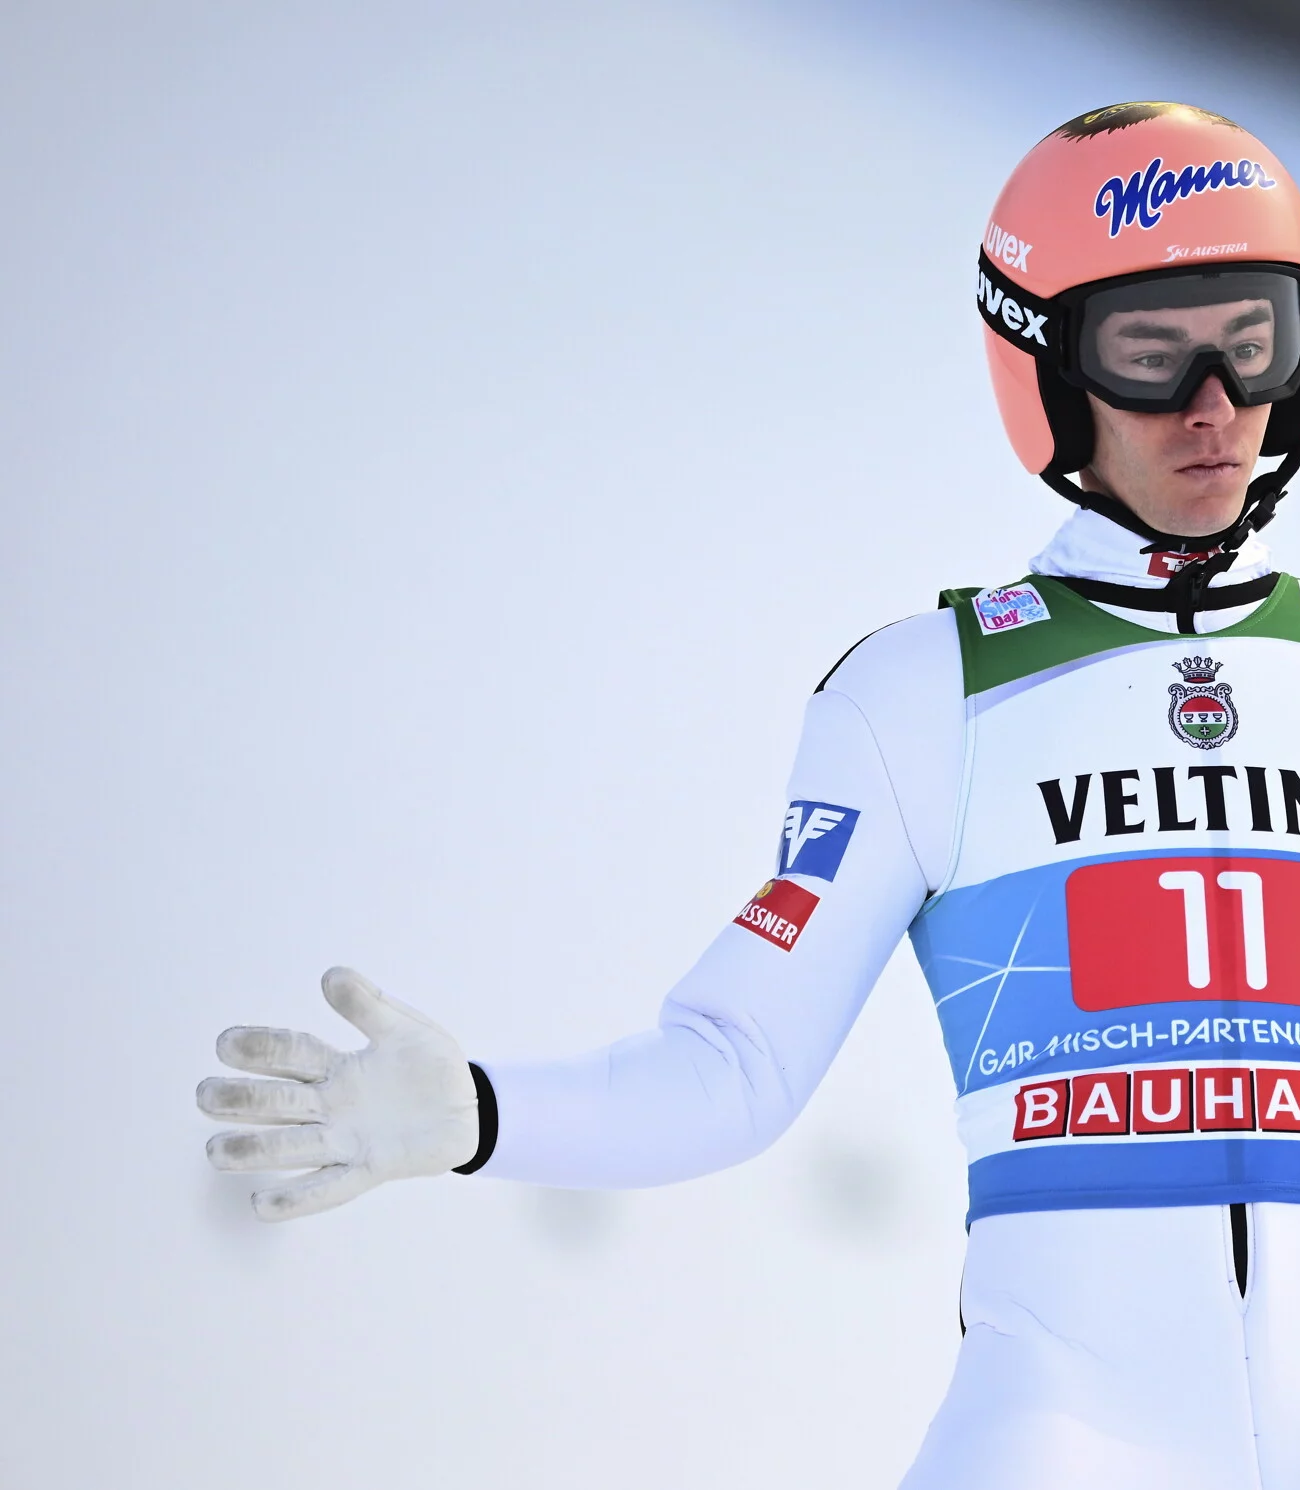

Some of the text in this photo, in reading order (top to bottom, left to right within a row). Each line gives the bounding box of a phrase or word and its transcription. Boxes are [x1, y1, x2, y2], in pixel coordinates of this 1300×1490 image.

[1094, 158, 1277, 238] Manner
[986, 222, 1033, 273] uvex
[1161, 242, 1248, 263] SKI AUSTRIA
[977, 270, 1048, 347] uvex
[992, 609, 1019, 628] Day
[1158, 870, 1268, 991] 11
